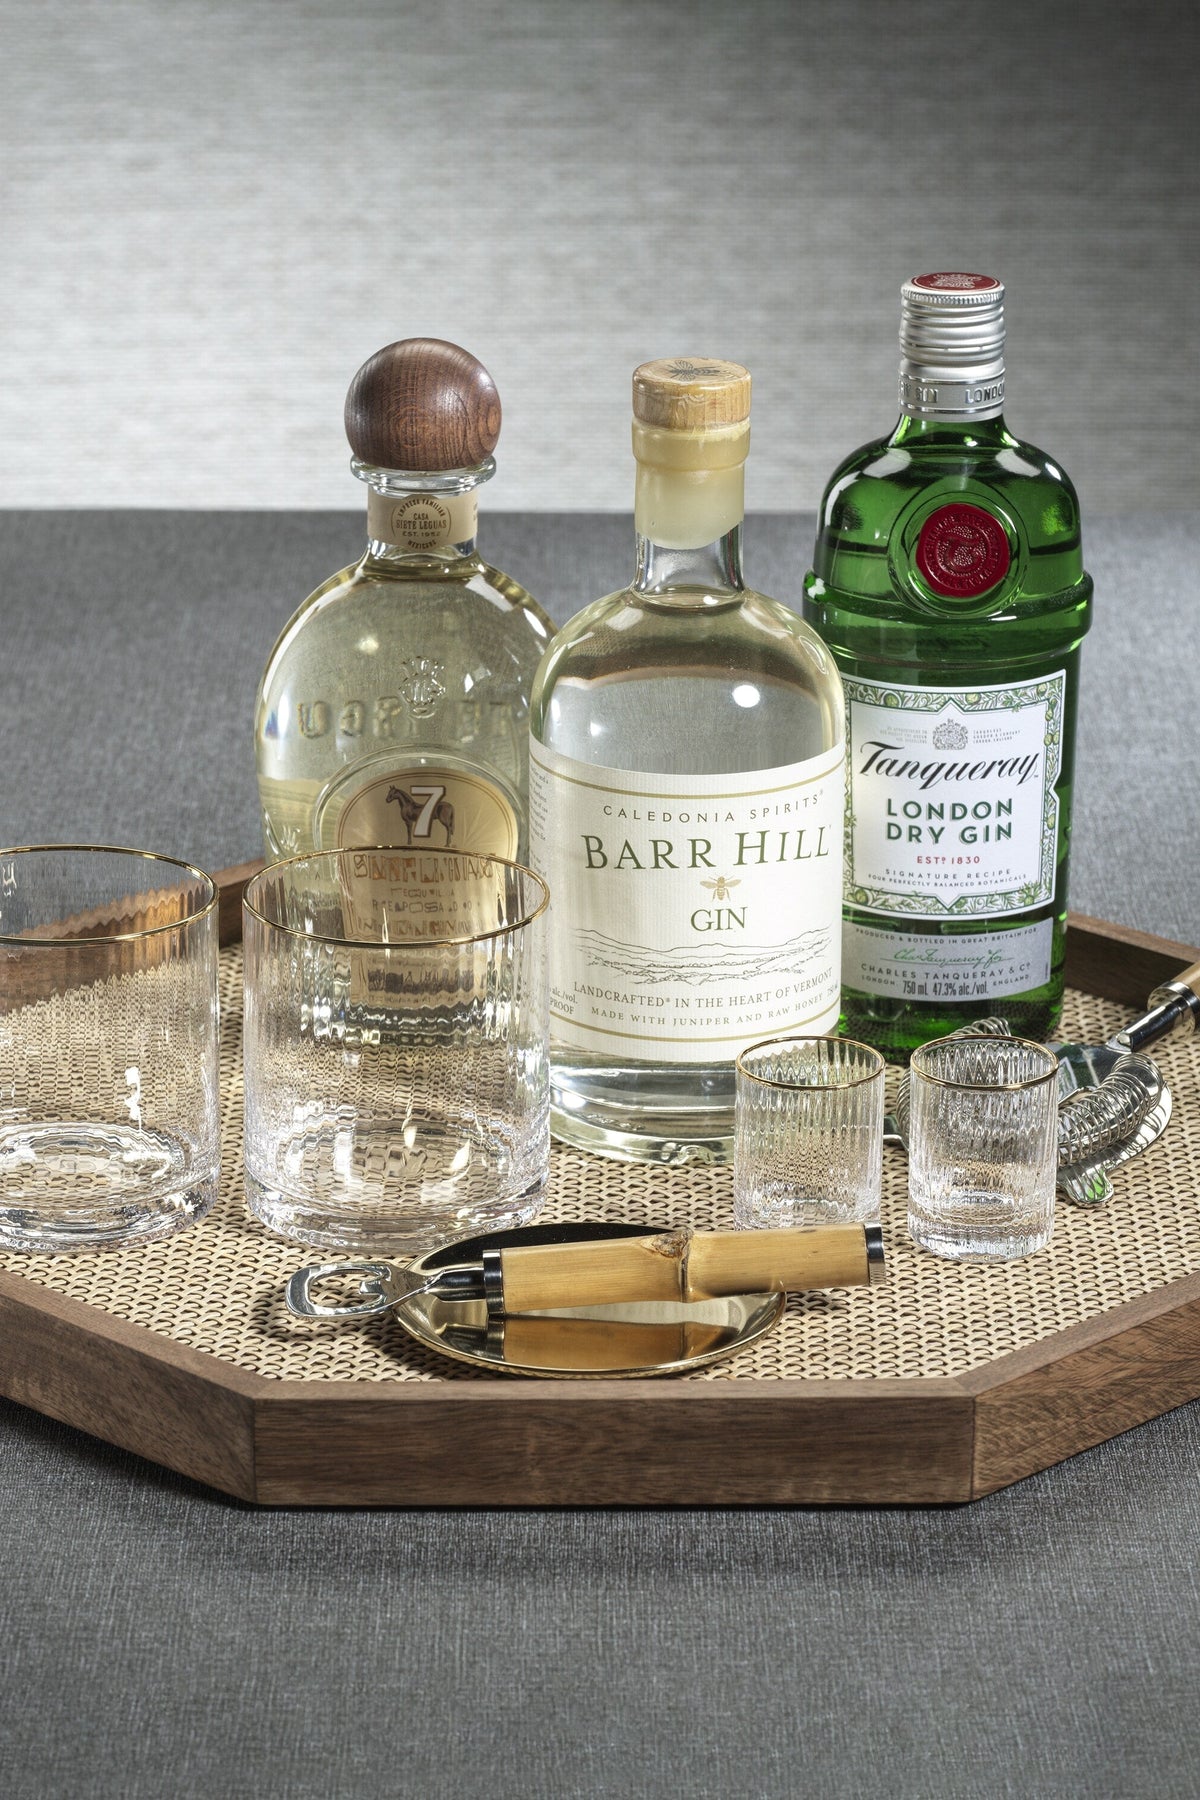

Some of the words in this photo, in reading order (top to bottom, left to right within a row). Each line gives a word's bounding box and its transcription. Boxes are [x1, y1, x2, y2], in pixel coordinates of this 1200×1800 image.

[396, 519, 417, 530] SIETE
[419, 519, 447, 530] LEGUAS
[413, 512, 429, 520] CASA
[859, 741, 1040, 790] Tanqueray
[410, 785, 447, 838] 7
[603, 805, 736, 823] CALEDONIA
[886, 798, 1013, 821] LONDON
[886, 822, 946, 845] DRY
[958, 821, 1012, 844] GIN
[581, 834, 717, 870] BARR
[733, 826, 830, 866] HILL
[951, 855, 980, 865] 1830
[885, 868, 958, 880] SIGNATURE
[967, 868, 1011, 880] RECIPE
[889, 878, 931, 887] PERFECTLY
[978, 873, 1027, 886] BOTANICALS
[690, 906, 748, 932] GIN
[856, 927, 895, 940] PRODUCED
[961, 936, 988, 944] GREAT
[991, 932, 1022, 942] BRITAIN
[1024, 927, 1037, 935] FOR
[861, 963, 917, 979] CHARLES
[924, 968, 1004, 980] TANQUERAY
[1008, 966, 1014, 974] &
[861, 974, 896, 986] LONDON
[992, 974, 1030, 986] ENGLAND
[552, 987, 578, 1004] alc./vol.
[675, 998, 690, 1008] IN
[694, 998, 724, 1008] THE
[729, 991, 772, 1006] HEART
[775, 987, 791, 999] OF
[793, 966, 833, 994] VERMONT
[903, 980, 916, 994] 750
[917, 982, 928, 996] mL
[932, 982, 957, 996] 47.3%
[958, 981, 989, 996] alc./vol.
[591, 1006, 624, 1020] MADE
[631, 1014, 665, 1025] WITH
[673, 1017, 730, 1026] JUNIPER
[736, 1013, 762, 1024] AND
[768, 1006, 790, 1018] RAW
[795, 993, 823, 1012] HONEY
